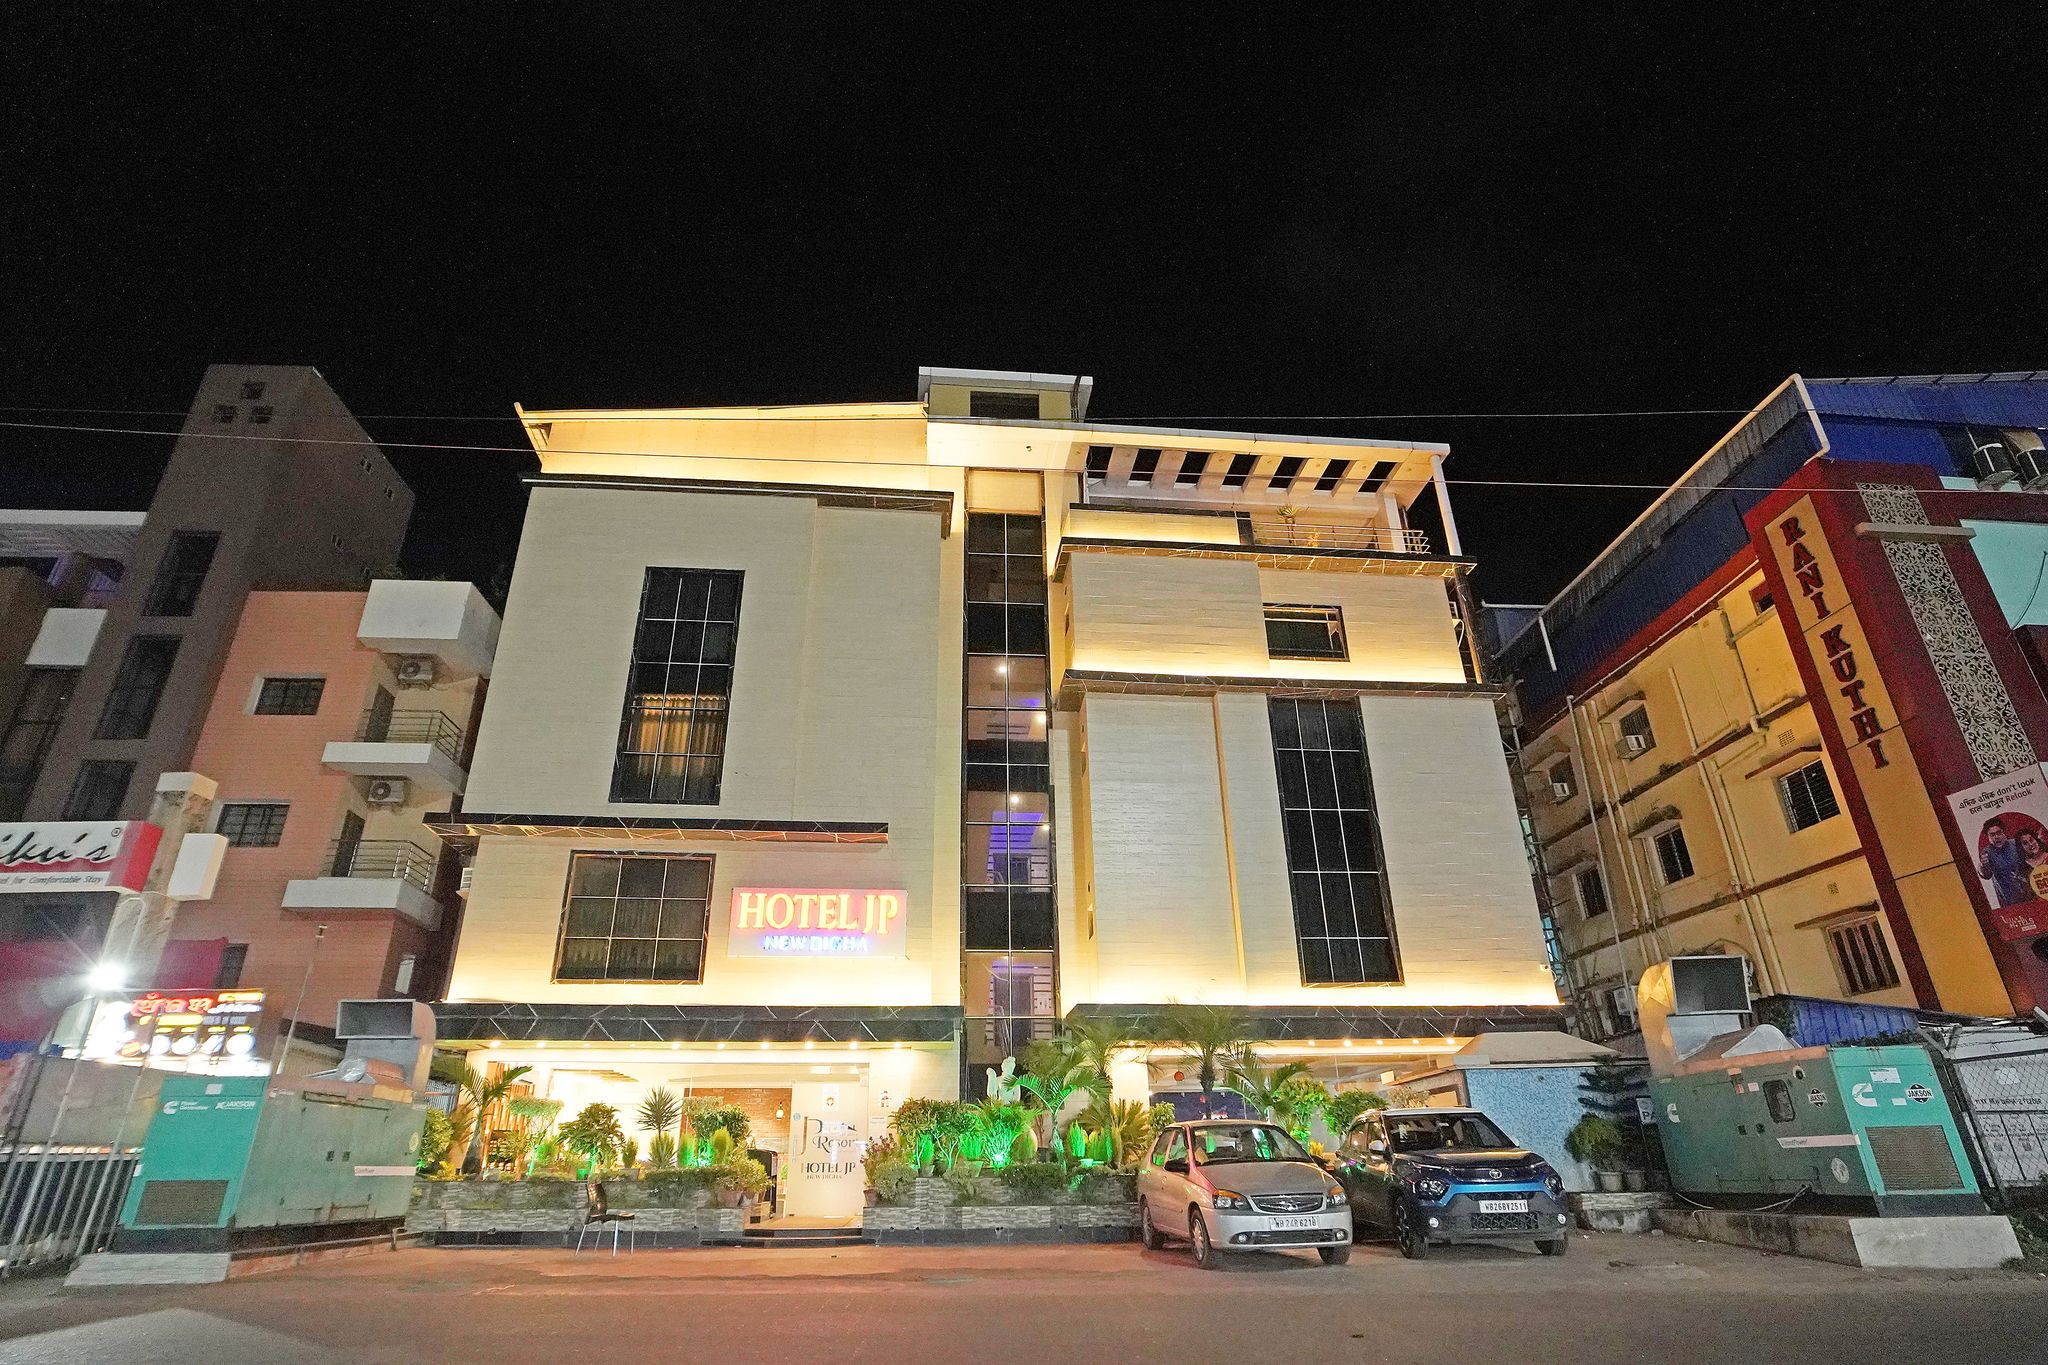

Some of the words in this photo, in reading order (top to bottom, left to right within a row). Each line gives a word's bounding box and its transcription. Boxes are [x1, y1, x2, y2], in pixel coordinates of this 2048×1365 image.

[1779, 516, 1832, 620] RANI
[1820, 624, 1889, 769] KUTHI
[1996, 784, 2017, 797] don't
[2017, 778, 2036, 789] look
[2005, 788, 2032, 803] Relook
[29, 876, 81, 887] Comfortable
[83, 875, 103, 885] Stay
[737, 892, 859, 930] HOTEL
[862, 894, 898, 935] JP
[763, 935, 807, 951] NEW
[810, 936, 869, 952] DIGHA
[1908, 1089, 1932, 1098] JAKSON
[801, 1162, 842, 1174] HOTEL
[844, 1162, 856, 1175] JP
